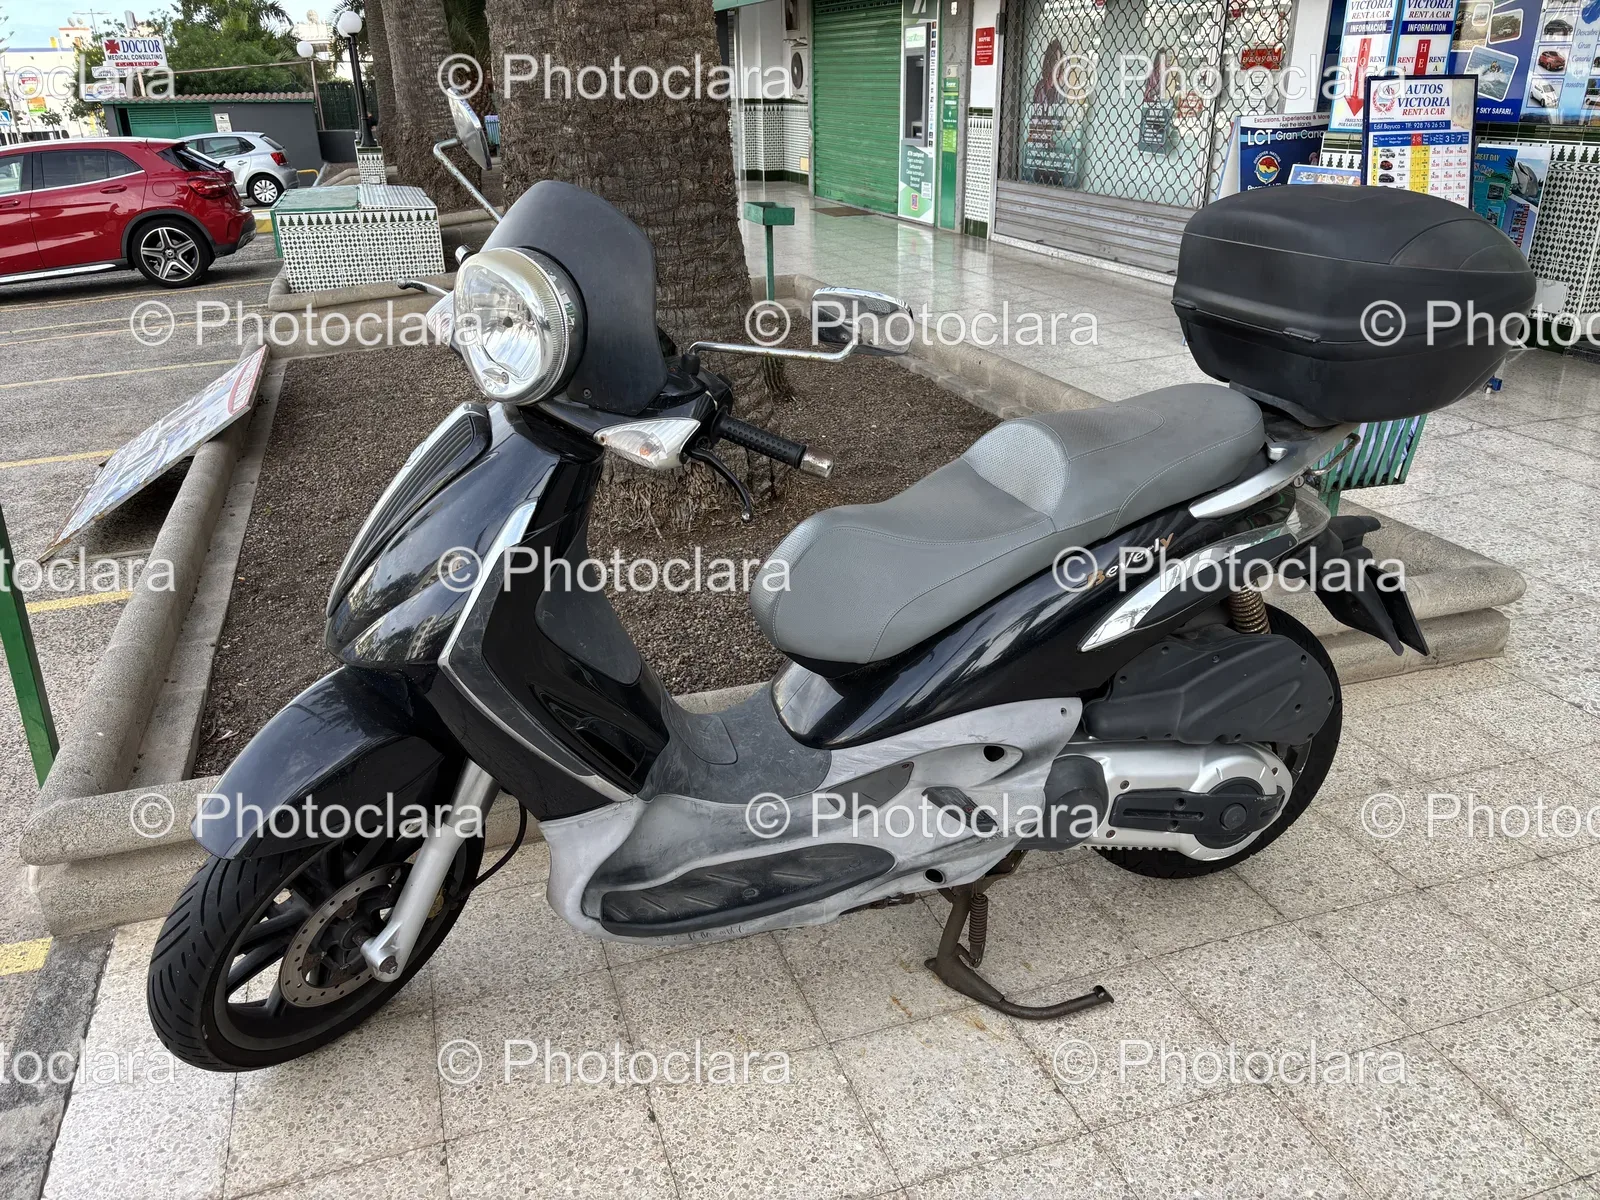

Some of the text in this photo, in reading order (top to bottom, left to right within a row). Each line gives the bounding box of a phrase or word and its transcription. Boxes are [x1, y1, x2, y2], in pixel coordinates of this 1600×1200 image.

[1351, 0, 1393, 10] VICTORIA
[1408, 0, 1454, 9] VICTORIA
[1352, 11, 1370, 19] RENT
[1408, 24, 1446, 32] INFORMATION
[121, 40, 161, 53] DOCTOR
[1405, 84, 1443, 94] AUTOS
[1398, 97, 1450, 108] VICTORIA
[1248, 129, 1272, 146] LCT
[1276, 131, 1298, 140] Gran
